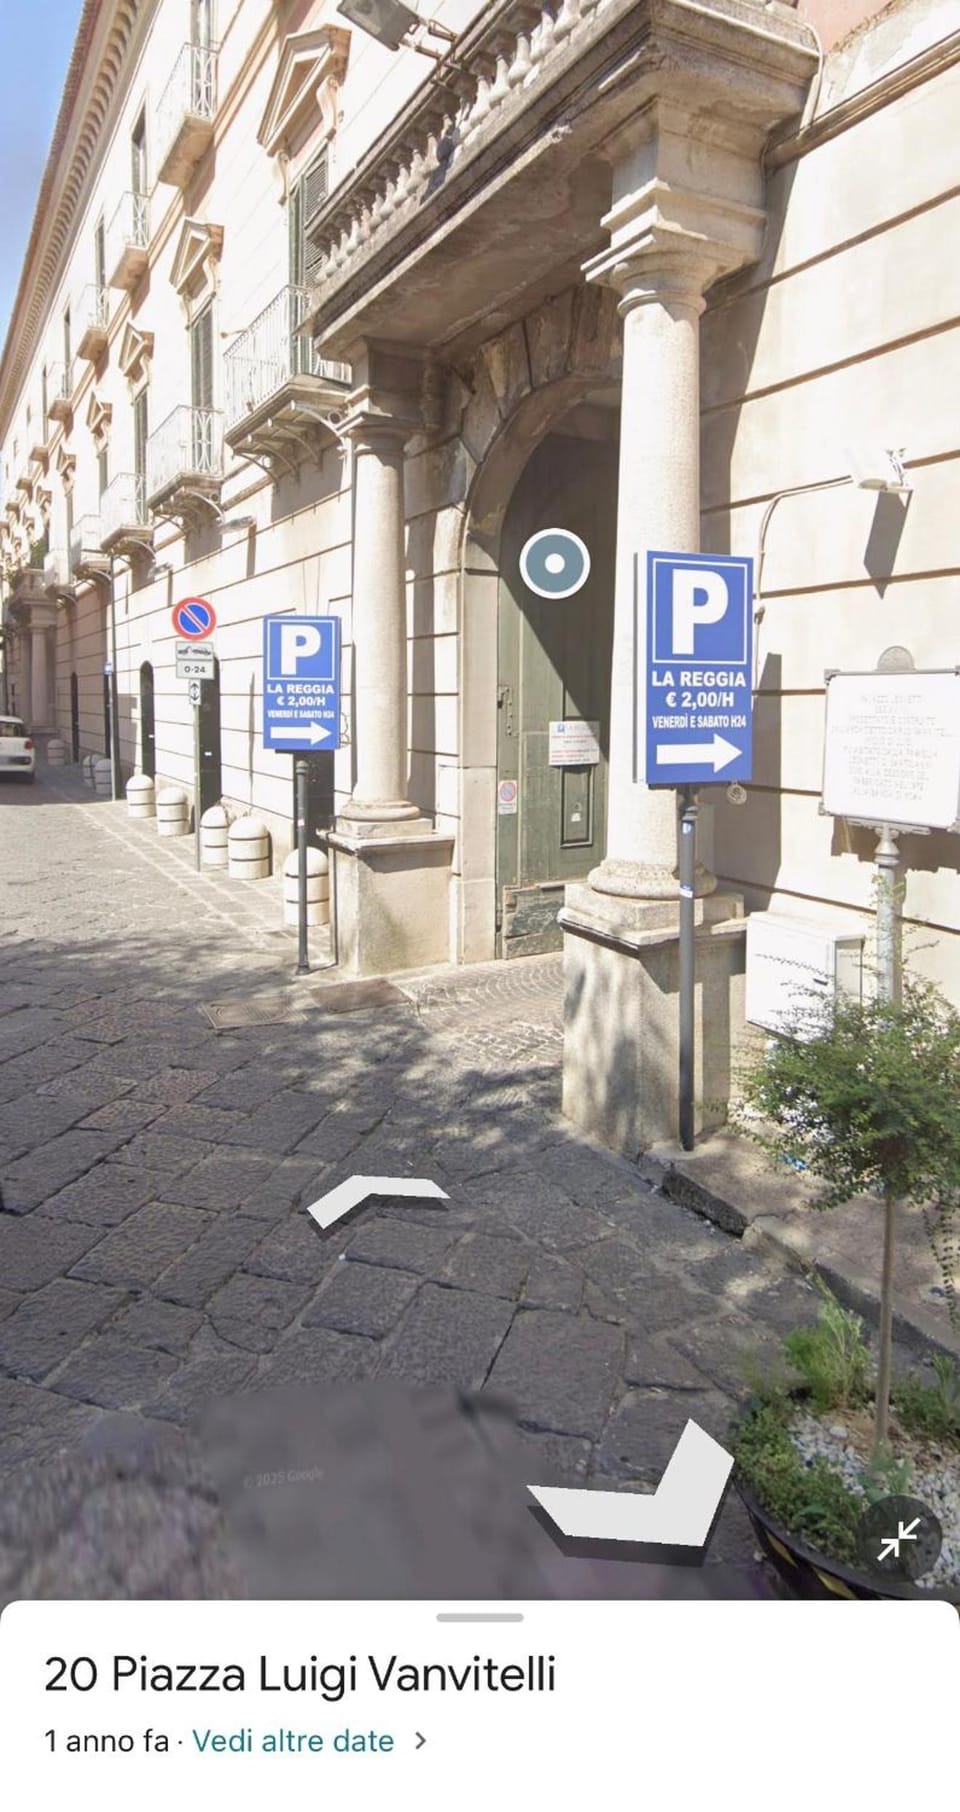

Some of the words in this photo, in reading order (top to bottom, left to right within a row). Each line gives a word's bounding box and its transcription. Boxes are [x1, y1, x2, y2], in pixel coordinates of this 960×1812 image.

[672, 568, 729, 655] P
[281, 624, 321, 675] P
[184, 665, 206, 674] 0-24
[652, 671, 675, 687] LA
[680, 671, 747, 687] REGGIA
[267, 684, 283, 694] LA
[287, 684, 335, 694] REGGIA
[276, 696, 285, 706] €
[287, 696, 326, 708] 2,00/H
[665, 692, 677, 708] €
[681, 692, 735, 711] 2,00/H
[652, 712, 688, 729] VENERDÌ
[690, 715, 696, 729] E
[697, 715, 729, 729] SABATO
[731, 715, 747, 729] H24
